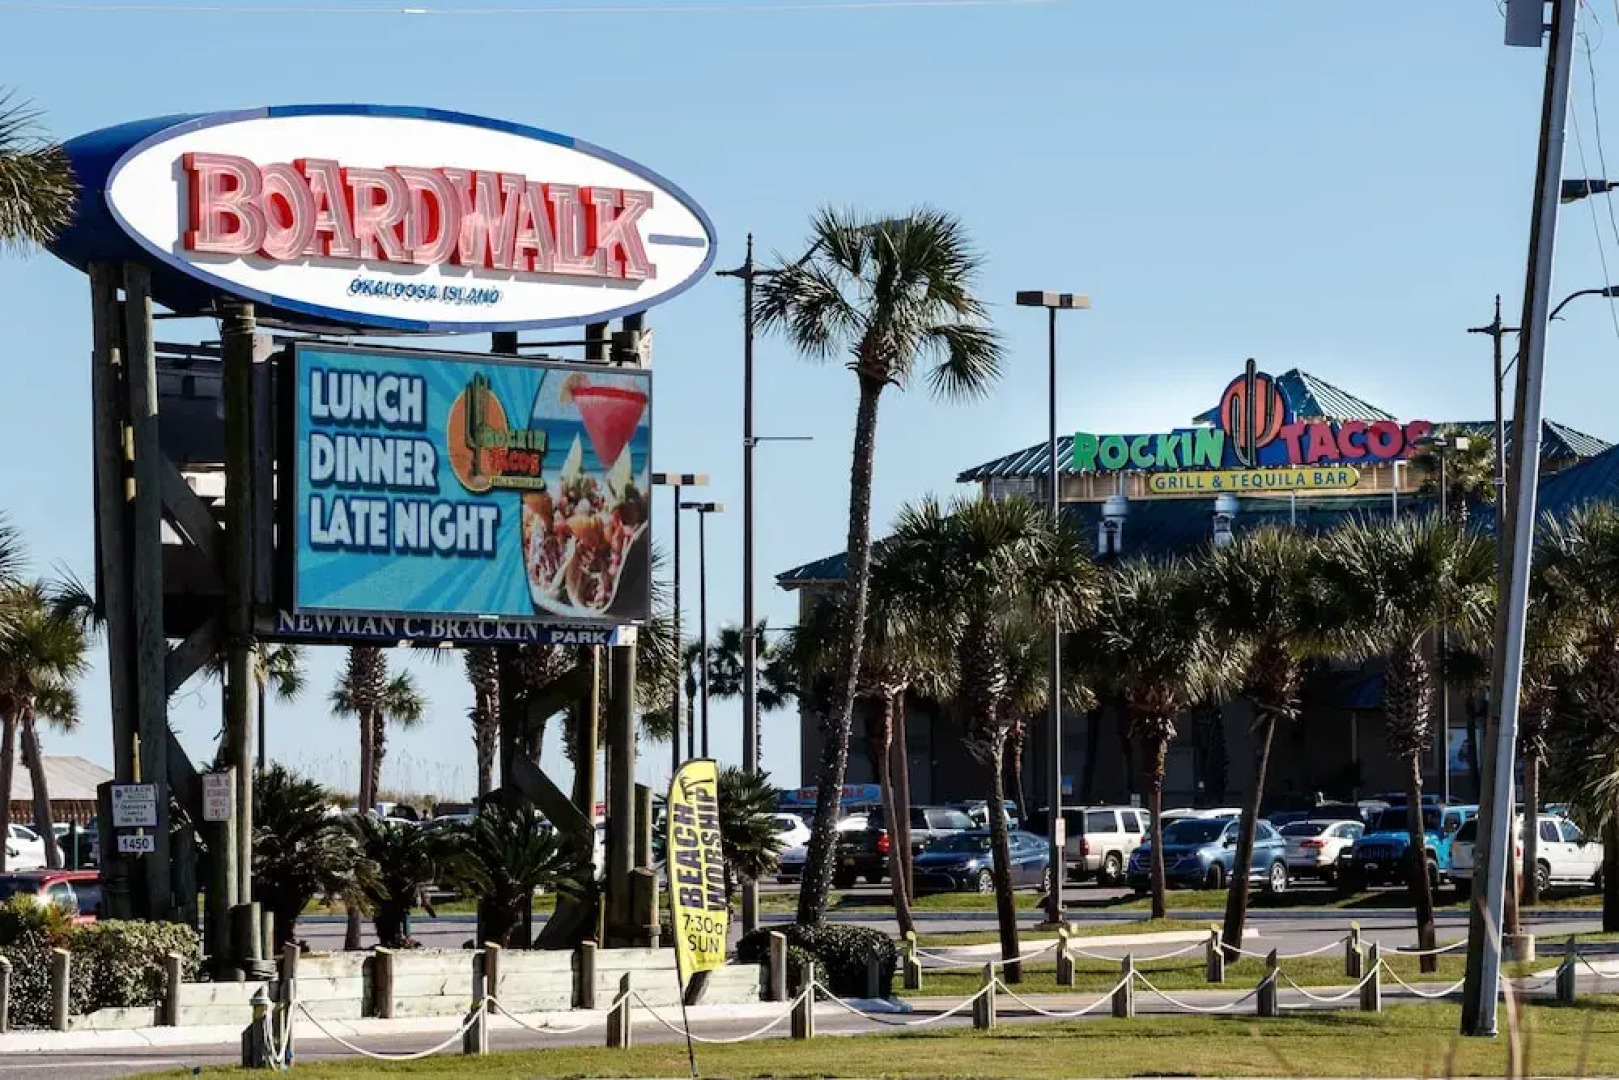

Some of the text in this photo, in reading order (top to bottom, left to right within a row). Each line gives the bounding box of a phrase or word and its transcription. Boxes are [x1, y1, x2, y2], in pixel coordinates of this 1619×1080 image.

[183, 151, 657, 280] BOARDWALK
[347, 277, 501, 304] OKALOOSA ISLAND
[310, 370, 424, 424] LUNCH
[310, 435, 437, 488] DINNER
[1073, 421, 1434, 471] ROCKIN TACOS
[1154, 469, 1349, 490] GRILL & TEQUILA BAR
[309, 496, 499, 552] LATE NIGHT
[278, 609, 539, 640] NEWMAN C. BRACKIN
[550, 630, 607, 644] PARK
[122, 838, 150, 850] 1450
[672, 802, 705, 909] BEACH
[695, 788, 725, 911] WORSHIP
[682, 915, 723, 936] 7:30a
[687, 935, 720, 954] SUN
